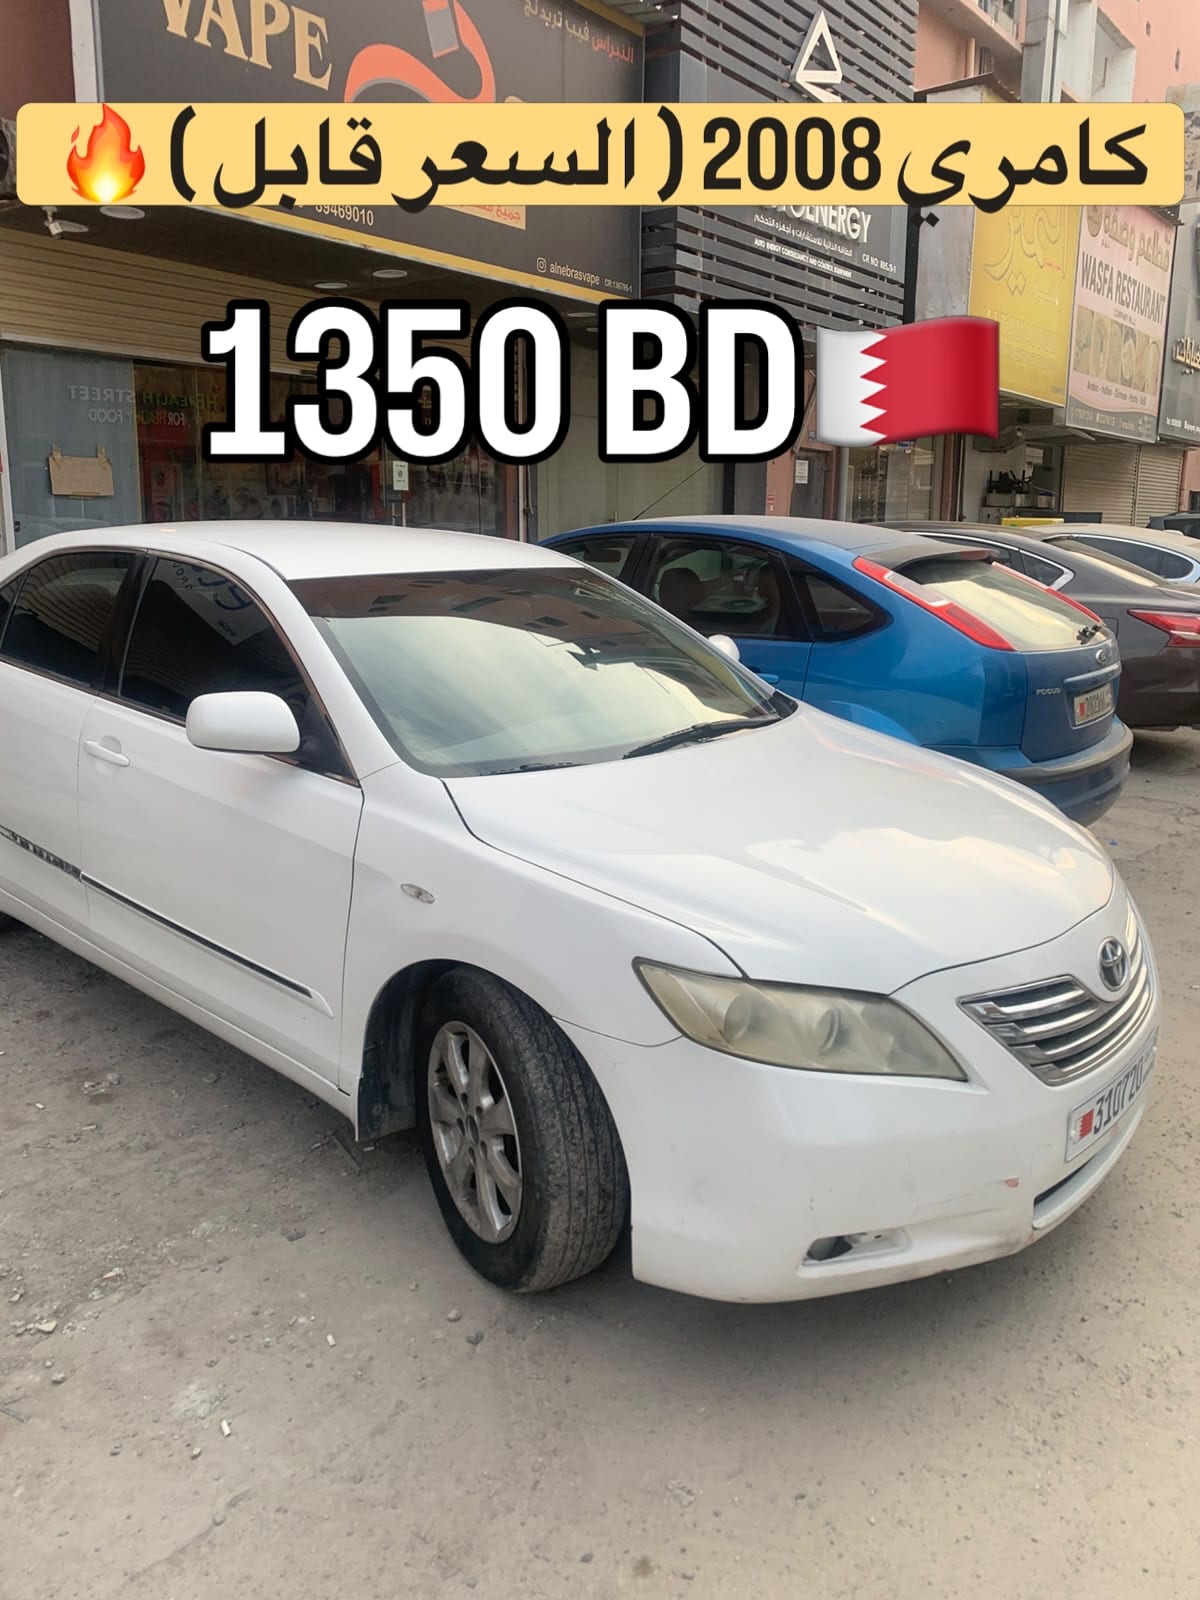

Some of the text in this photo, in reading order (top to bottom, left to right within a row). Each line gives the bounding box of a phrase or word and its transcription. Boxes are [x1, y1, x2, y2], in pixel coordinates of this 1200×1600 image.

[162, 0, 333, 91] VAPE
[549, 262, 600, 286] alnebrasvape
[1081, 251, 1114, 301] WASFA
[1114, 270, 1166, 325] RESTAURANT
[1036, 687, 1061, 696] FOCUS
[1094, 1055, 1144, 1135] 310720
